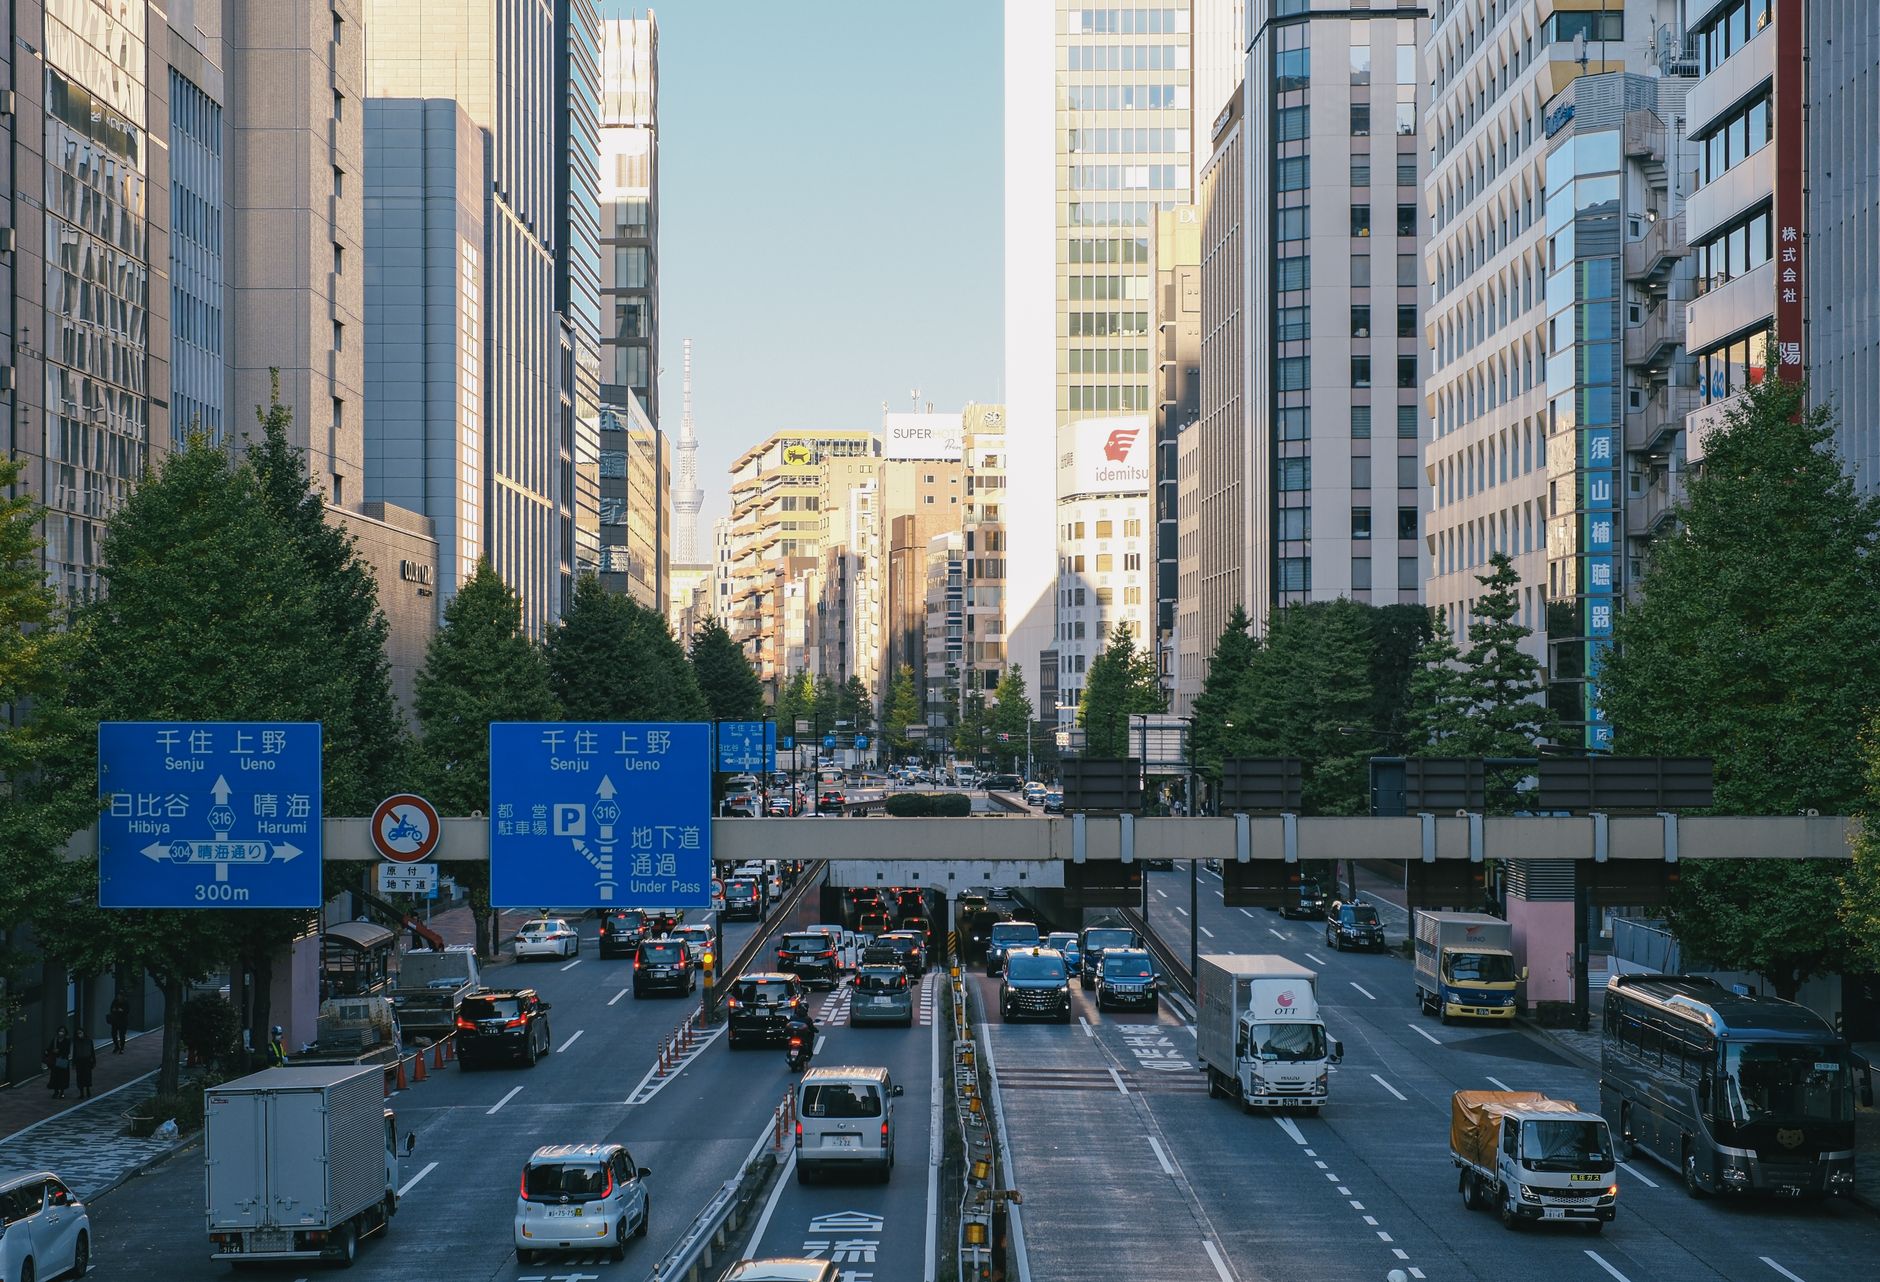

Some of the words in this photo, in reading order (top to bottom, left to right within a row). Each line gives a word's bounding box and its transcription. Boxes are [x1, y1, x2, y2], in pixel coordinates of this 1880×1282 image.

[1782, 227, 1797, 303] 株式会社
[1778, 342, 1800, 365] 陽
[893, 428, 932, 439] SUPER
[1096, 466, 1149, 481] idemitsu
[1591, 436, 1610, 629] 須山補聴器
[156, 730, 213, 754] 千住
[229, 730, 286, 754] 上野
[541, 730, 599, 754] 千住
[614, 730, 671, 754] 上野
[165, 757, 204, 772] Senju
[241, 757, 275, 770] Ueno
[550, 758, 589, 773] Senju
[625, 758, 660, 770] Ueno
[111, 794, 189, 817] 日比谷
[254, 794, 311, 818] 晴海
[497, 804, 547, 819] 都営
[597, 807, 615, 819] 316
[212, 812, 231, 825] 316
[561, 807, 580, 832] P
[128, 821, 170, 836] Hibiya
[258, 821, 307, 834] Harumi
[497, 820, 548, 836] 駐車場
[631, 826, 700, 849] 地下道
[172, 846, 190, 858] 304
[198, 844, 262, 860] 晴海通り
[386, 866, 416, 876] 原付
[631, 853, 676, 877] 通過
[195, 885, 249, 900] 300m
[386, 880, 425, 890] 地下道
[630, 880, 666, 893] Under
[671, 881, 700, 893] Pass
